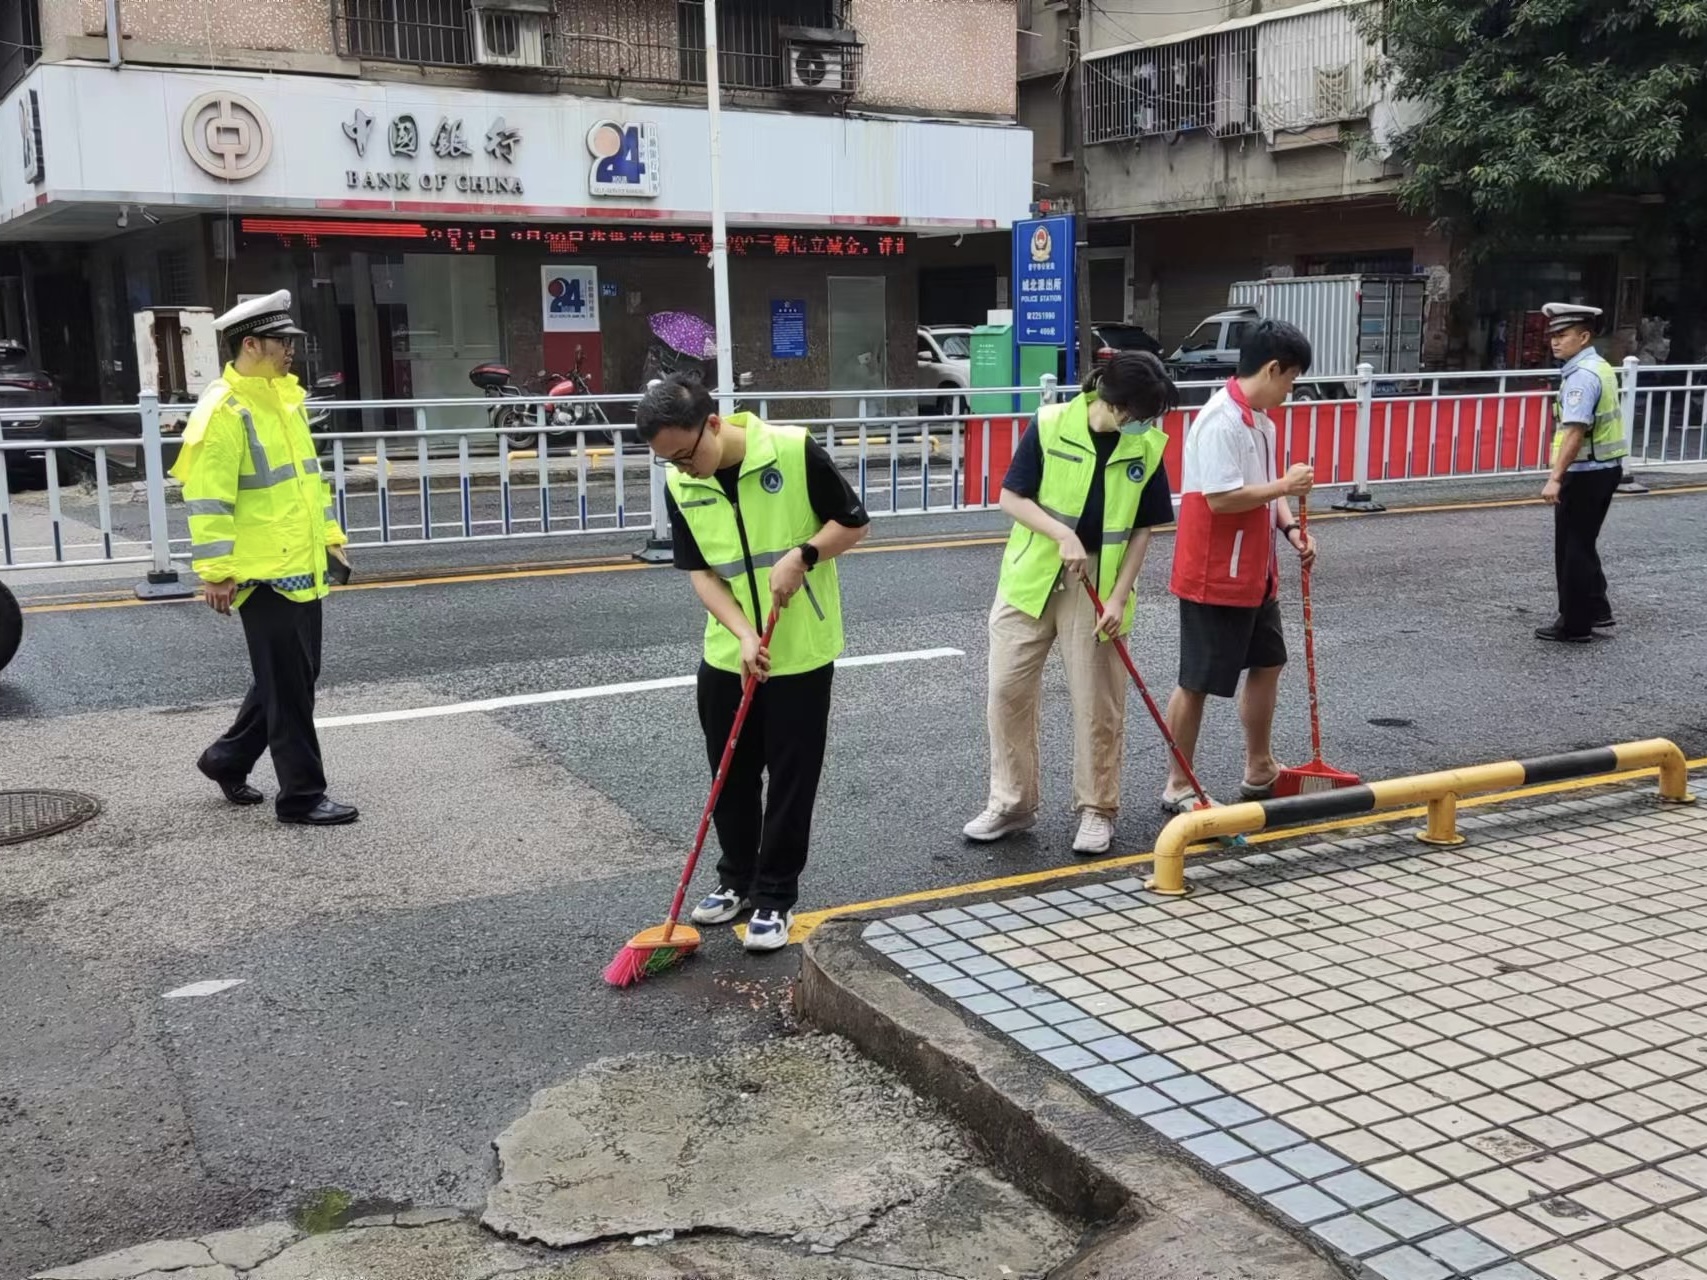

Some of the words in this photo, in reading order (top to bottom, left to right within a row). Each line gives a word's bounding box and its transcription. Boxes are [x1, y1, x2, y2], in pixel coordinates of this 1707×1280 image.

[342, 108, 522, 164] 中国银行
[594, 122, 646, 184] 24
[346, 170, 411, 190] BANK
[419, 173, 447, 190] OF
[455, 175, 524, 194] CHINA
[548, 277, 585, 313] 24
[1022, 278, 1062, 291] 城北派出所
